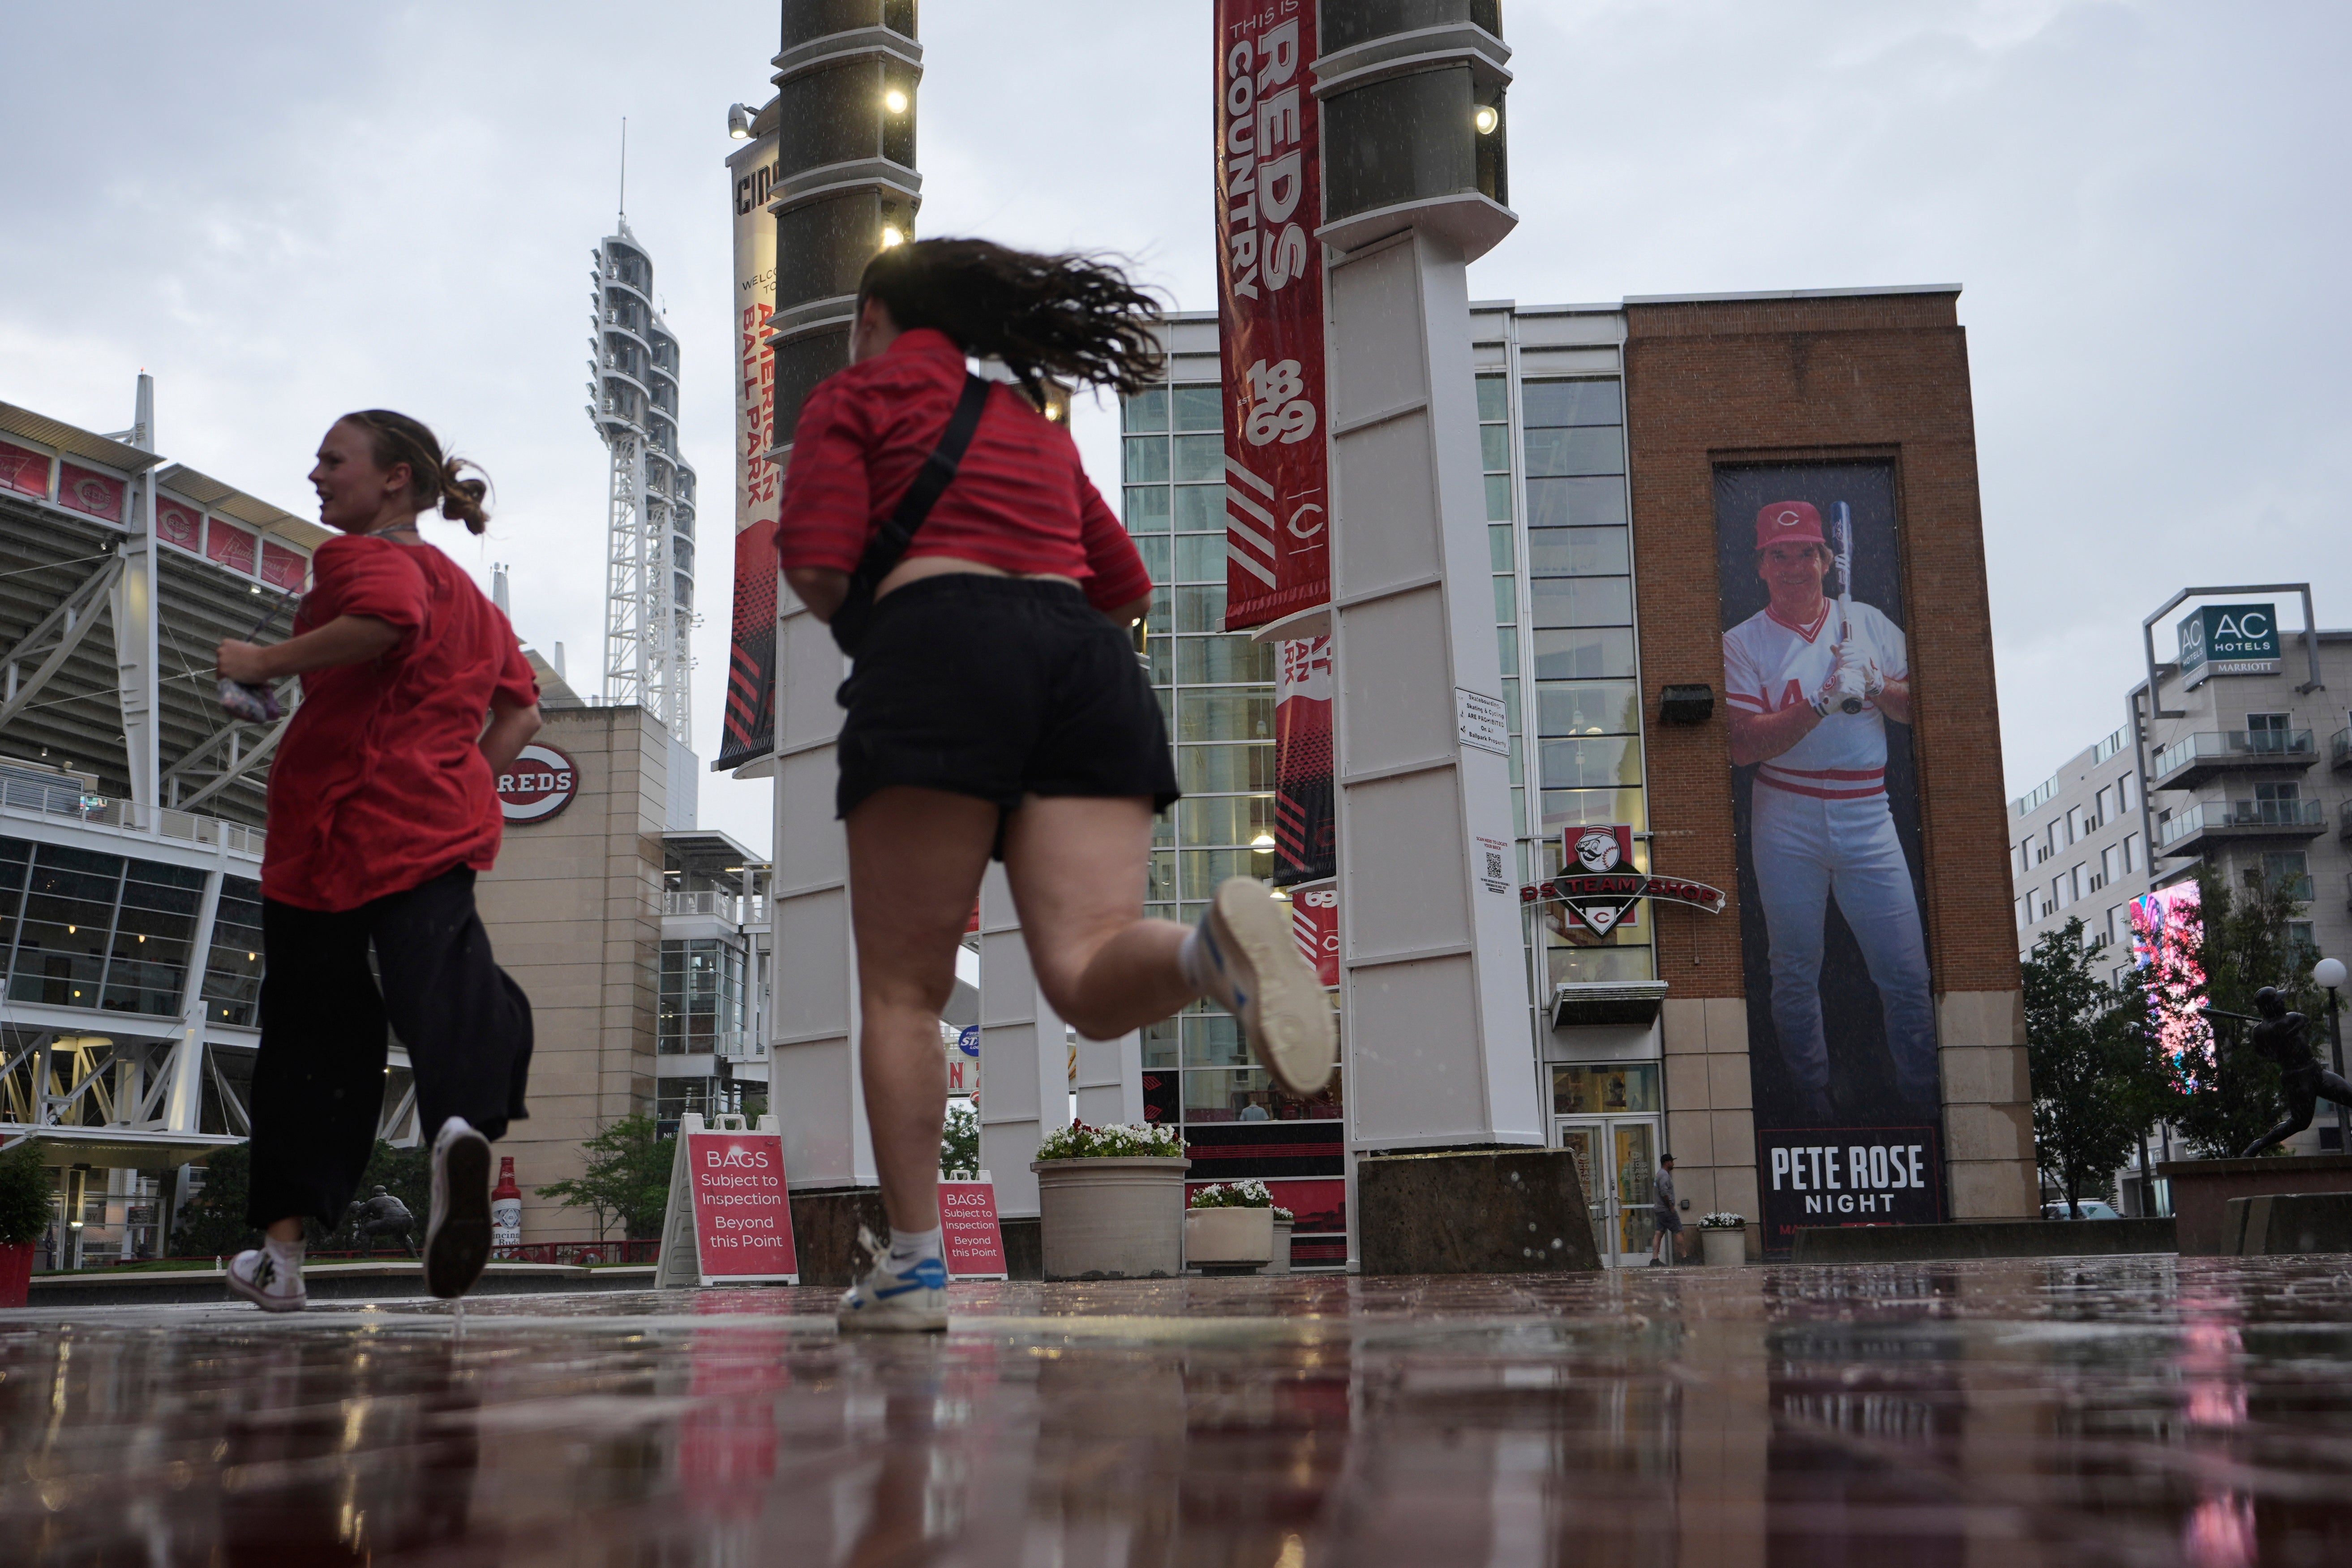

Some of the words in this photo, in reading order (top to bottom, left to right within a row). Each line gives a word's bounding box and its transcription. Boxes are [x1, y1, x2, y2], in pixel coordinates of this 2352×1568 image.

[1230, 7, 1275, 39] THIS
[1257, 17, 1307, 292] REDS
[1228, 39, 1258, 300] COUNTRY
[743, 304, 758, 400] BALL
[1246, 359, 1304, 404] 18
[1237, 395, 1252, 407] EST
[1245, 400, 1317, 447] 69
[747, 405, 760, 508] PARK
[84, 490, 112, 503] REDS
[168, 518, 190, 533] REDS
[2214, 612, 2268, 640] AC
[2182, 620, 2202, 656] AC
[2215, 641, 2271, 652] HOTELS
[2183, 648, 2203, 667] HOTELS
[2218, 662, 2272, 672] MARRIOTT
[1467, 703, 1483, 713] Skating
[1489, 709, 1504, 720] Cycling
[1478, 716, 1504, 727] PROHIBITED
[1469, 732, 1487, 741] Ballpark
[1489, 737, 1506, 747] Property
[497, 772, 572, 792] REDS
[1566, 877, 1636, 893] TEAM
[1647, 879, 1718, 902] SHOP
[707, 1151, 768, 1168] BAGS
[1771, 1146, 1841, 1190] PETE
[1849, 1145, 1924, 1189] ROSE
[701, 1173, 759, 1188] Subject
[763, 1175, 778, 1186] to
[703, 1192, 781, 1207] Inspection
[947, 1194, 986, 1206] BAGS
[1805, 1194, 1894, 1213] NIGHT
[944, 1209, 980, 1219] Subject
[715, 1216, 774, 1231] Beyond
[946, 1221, 995, 1230] Inspection
[710, 1235, 738, 1247] this
[743, 1235, 783, 1247] Point
[954, 1236, 991, 1246] Beyond
[952, 1248, 970, 1257] this
[972, 1248, 997, 1257] Point
